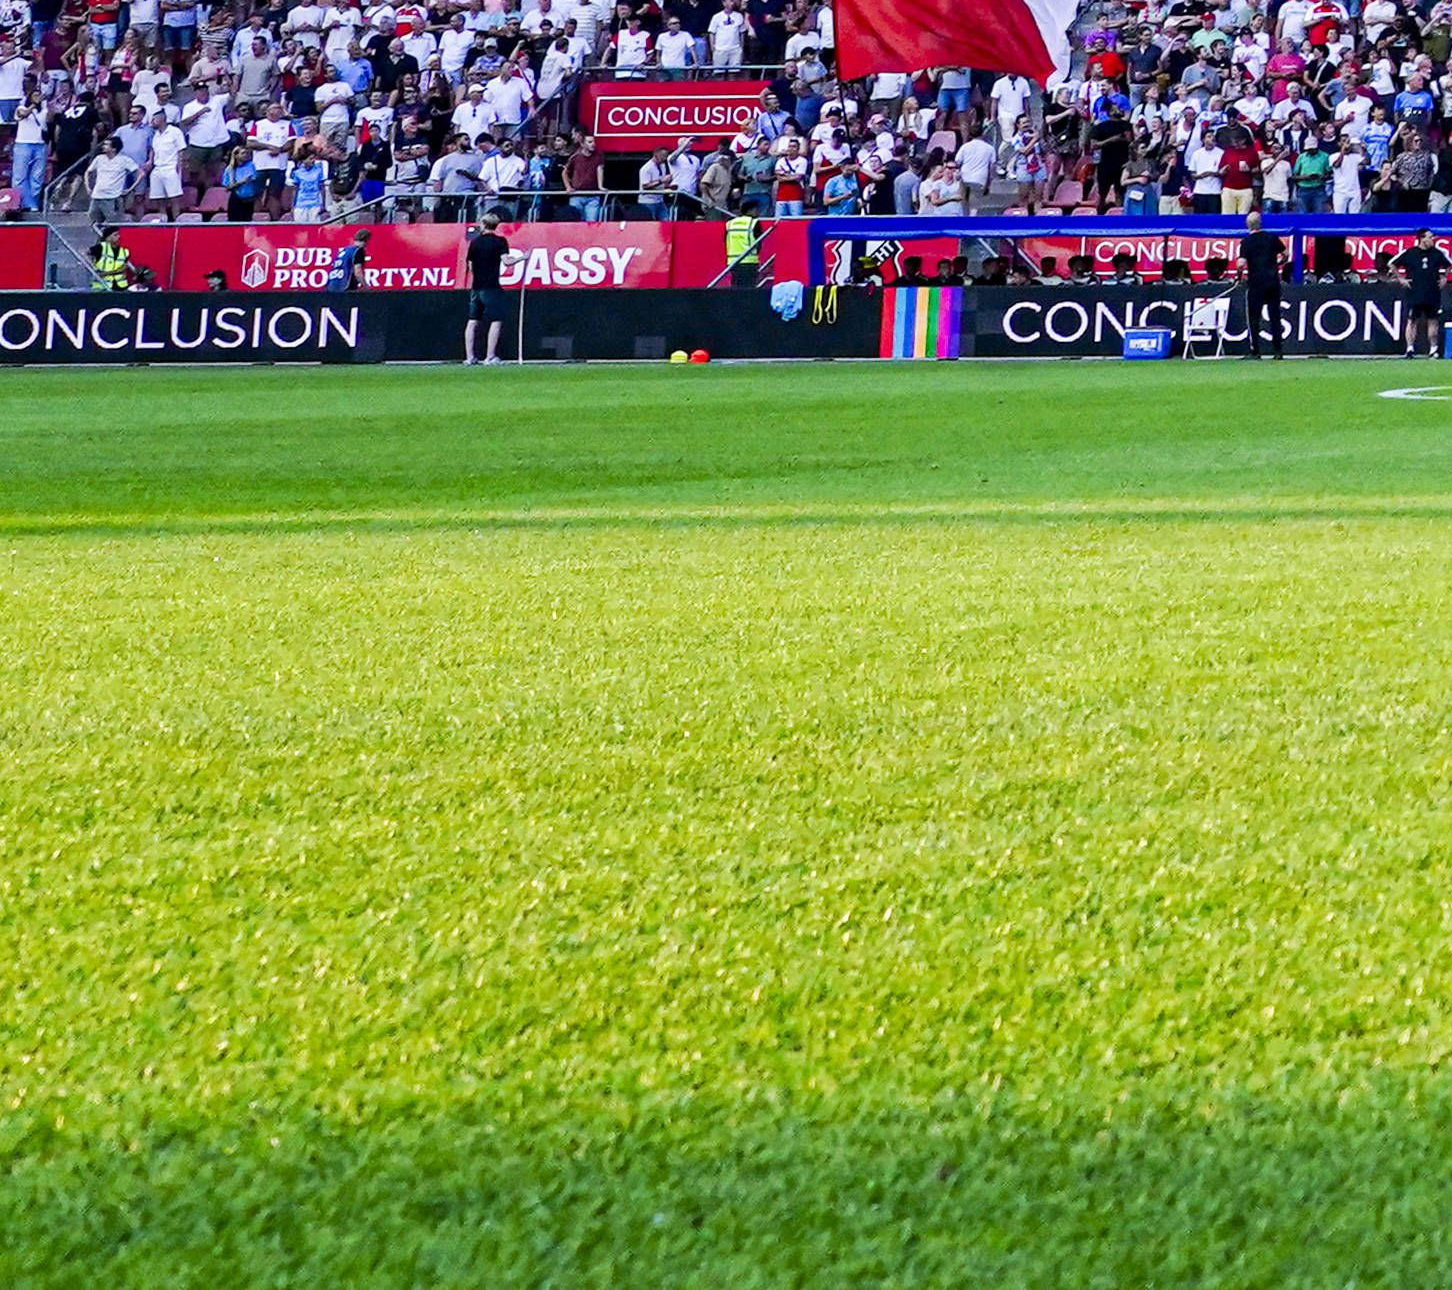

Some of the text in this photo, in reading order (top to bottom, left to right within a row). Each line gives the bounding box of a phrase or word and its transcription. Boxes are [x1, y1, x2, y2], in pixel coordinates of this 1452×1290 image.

[1095, 240, 1243, 263] CONCLUSI
[272, 266, 456, 289] PRORTY.NL
[499, 246, 638, 286] DASSY
